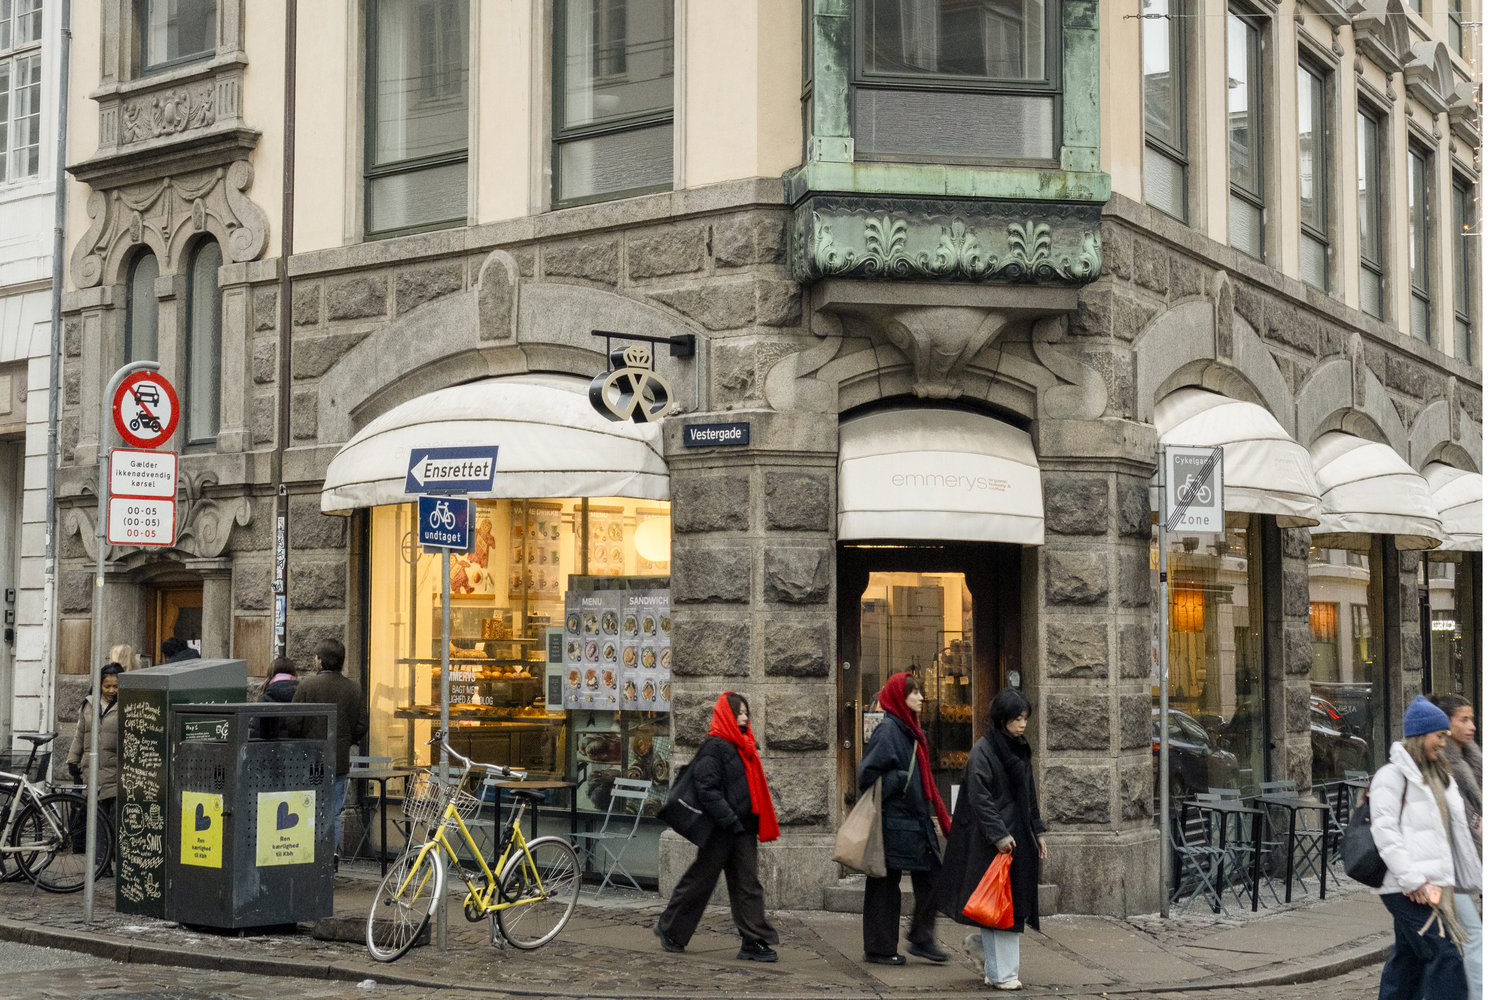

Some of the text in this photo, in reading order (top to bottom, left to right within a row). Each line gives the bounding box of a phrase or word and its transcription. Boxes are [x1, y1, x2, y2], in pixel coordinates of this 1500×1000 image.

[690, 426, 742, 442] Vestergade
[130, 460, 158, 469] Gælder
[1174, 456, 1209, 466] Cykelgad
[115, 469, 171, 480] ikkenødvendig
[424, 461, 489, 479] Ensrettet
[131, 480, 156, 488] kørsel
[891, 473, 988, 492] emmerys
[127, 506, 157, 516] 00-05
[123, 517, 160, 527] (00-05)
[1180, 513, 1210, 526] Zone
[126, 528, 157, 538] 00-05
[424, 530, 461, 543] undtaget
[581, 597, 603, 606] MENU
[629, 596, 669, 606] SANDWICH
